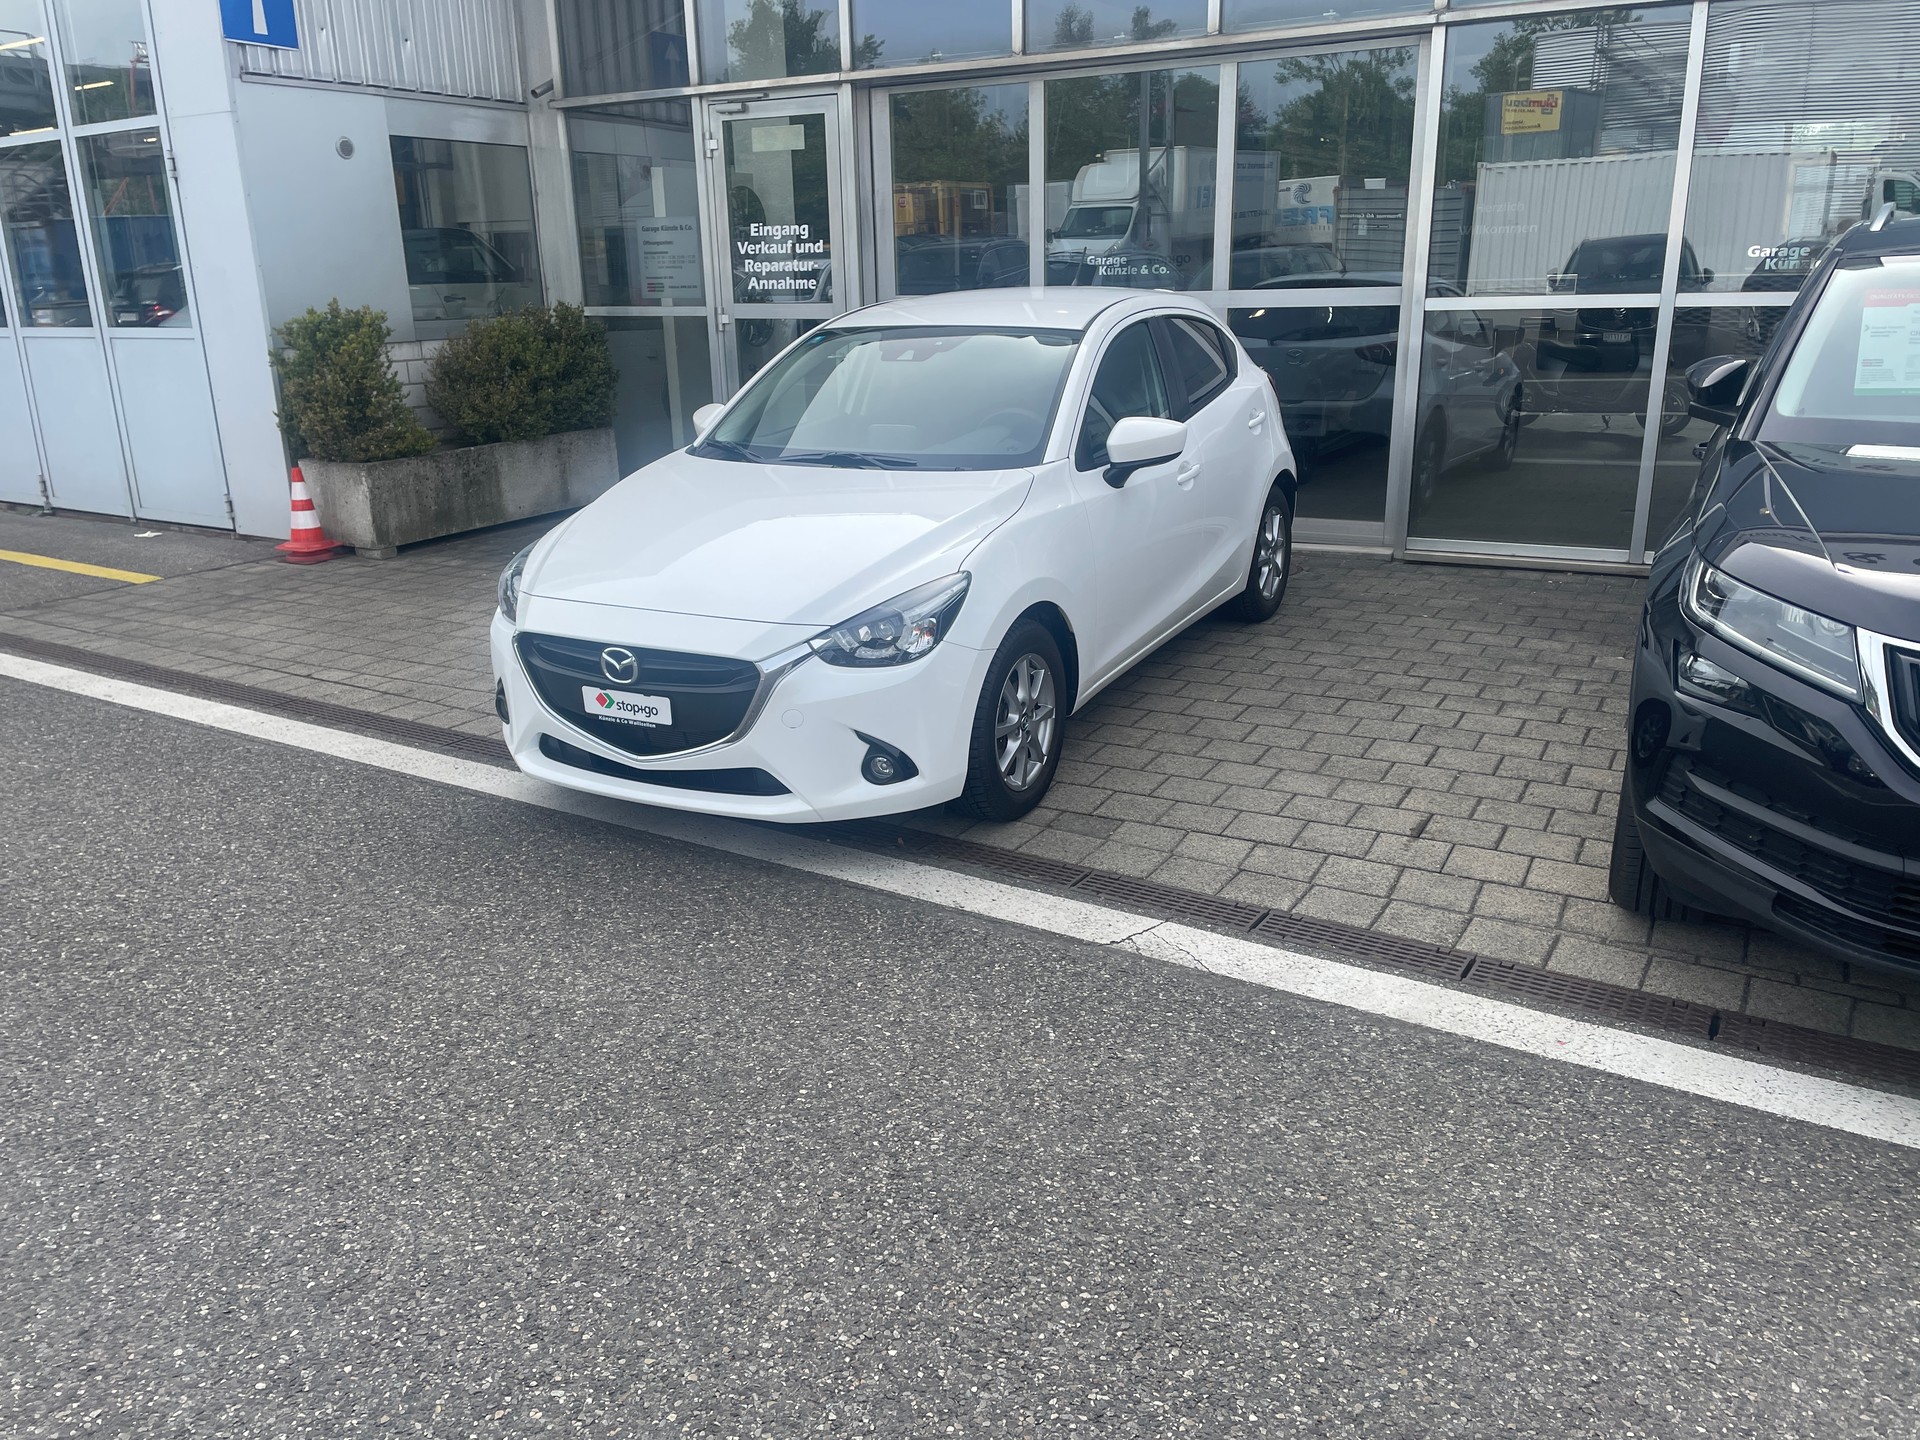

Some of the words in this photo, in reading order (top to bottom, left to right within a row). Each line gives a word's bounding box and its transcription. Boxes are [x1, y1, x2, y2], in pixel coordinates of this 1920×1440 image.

[750, 223, 809, 239] Eingang
[737, 240, 793, 254] Verkauf
[795, 240, 824, 253] und
[1747, 245, 1811, 260] Garage
[744, 259, 819, 276] Reparatur-
[1087, 256, 1128, 267] Garage
[1098, 265, 1138, 275] Künzle
[1140, 265, 1149, 275] &
[1151, 265, 1170, 274] Co.
[748, 277, 817, 290] Annahme
[616, 701, 658, 717] stop+go
[598, 715, 616, 723] Künzle
